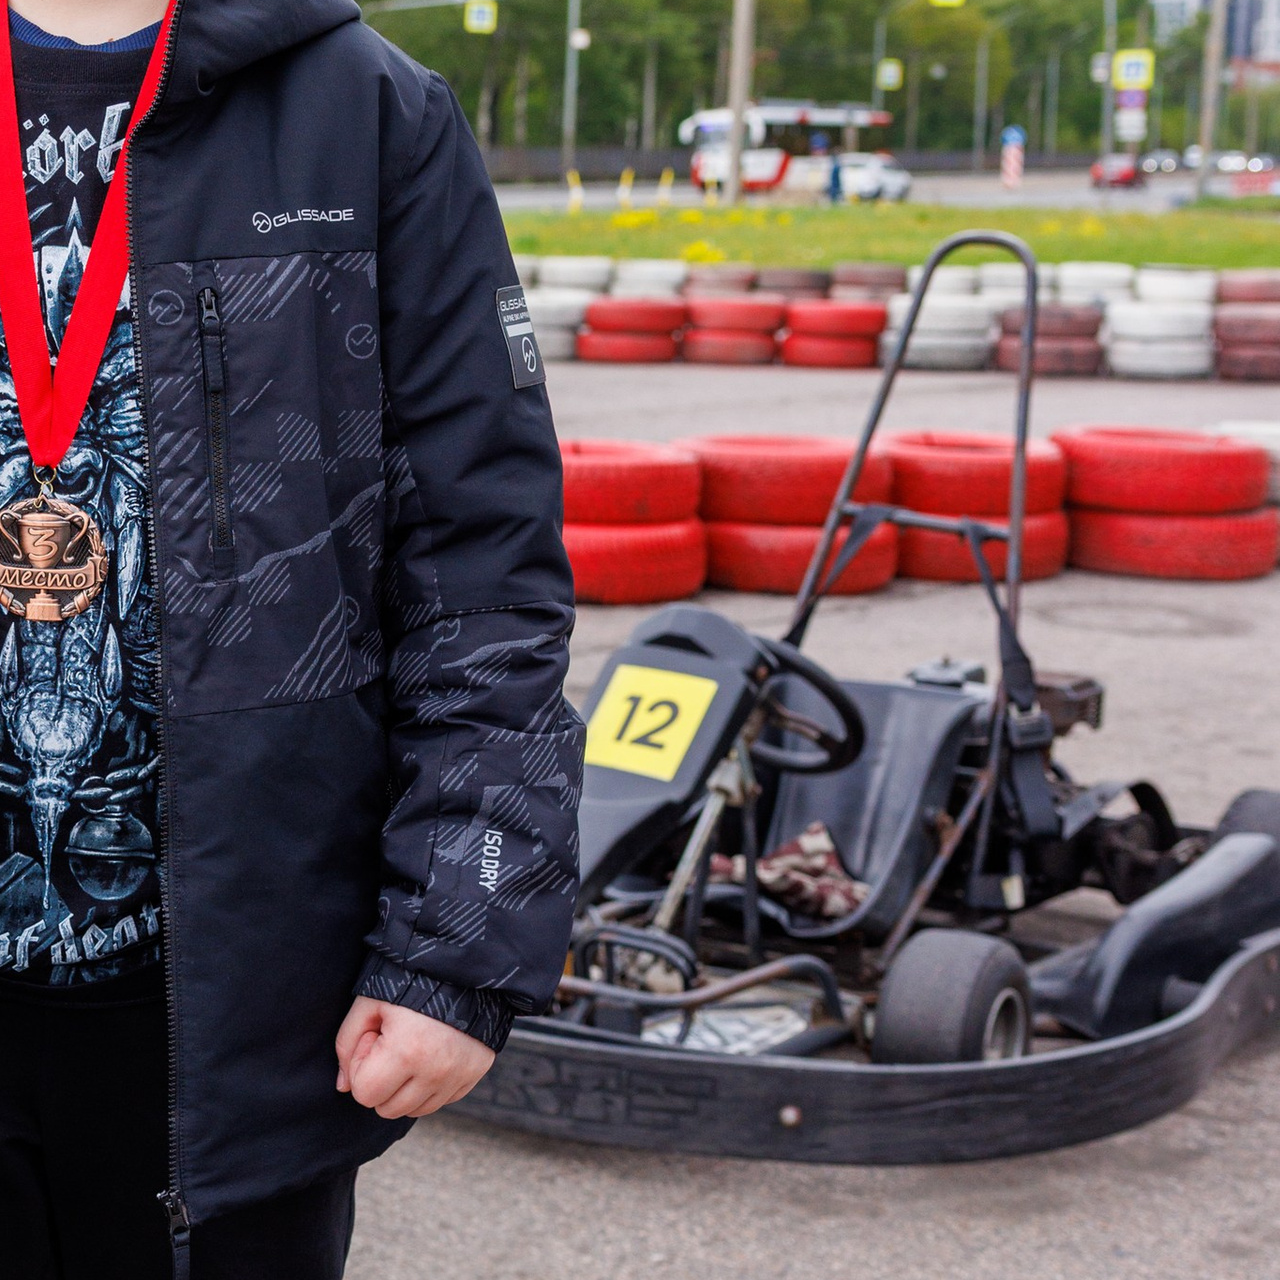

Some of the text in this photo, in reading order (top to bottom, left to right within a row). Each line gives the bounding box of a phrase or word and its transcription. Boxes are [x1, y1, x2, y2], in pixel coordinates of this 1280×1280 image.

[272, 208, 355, 228] GLISSADE
[27, 527, 59, 562] 3
[614, 695, 680, 749] 12
[51, 902, 161, 966] deat
